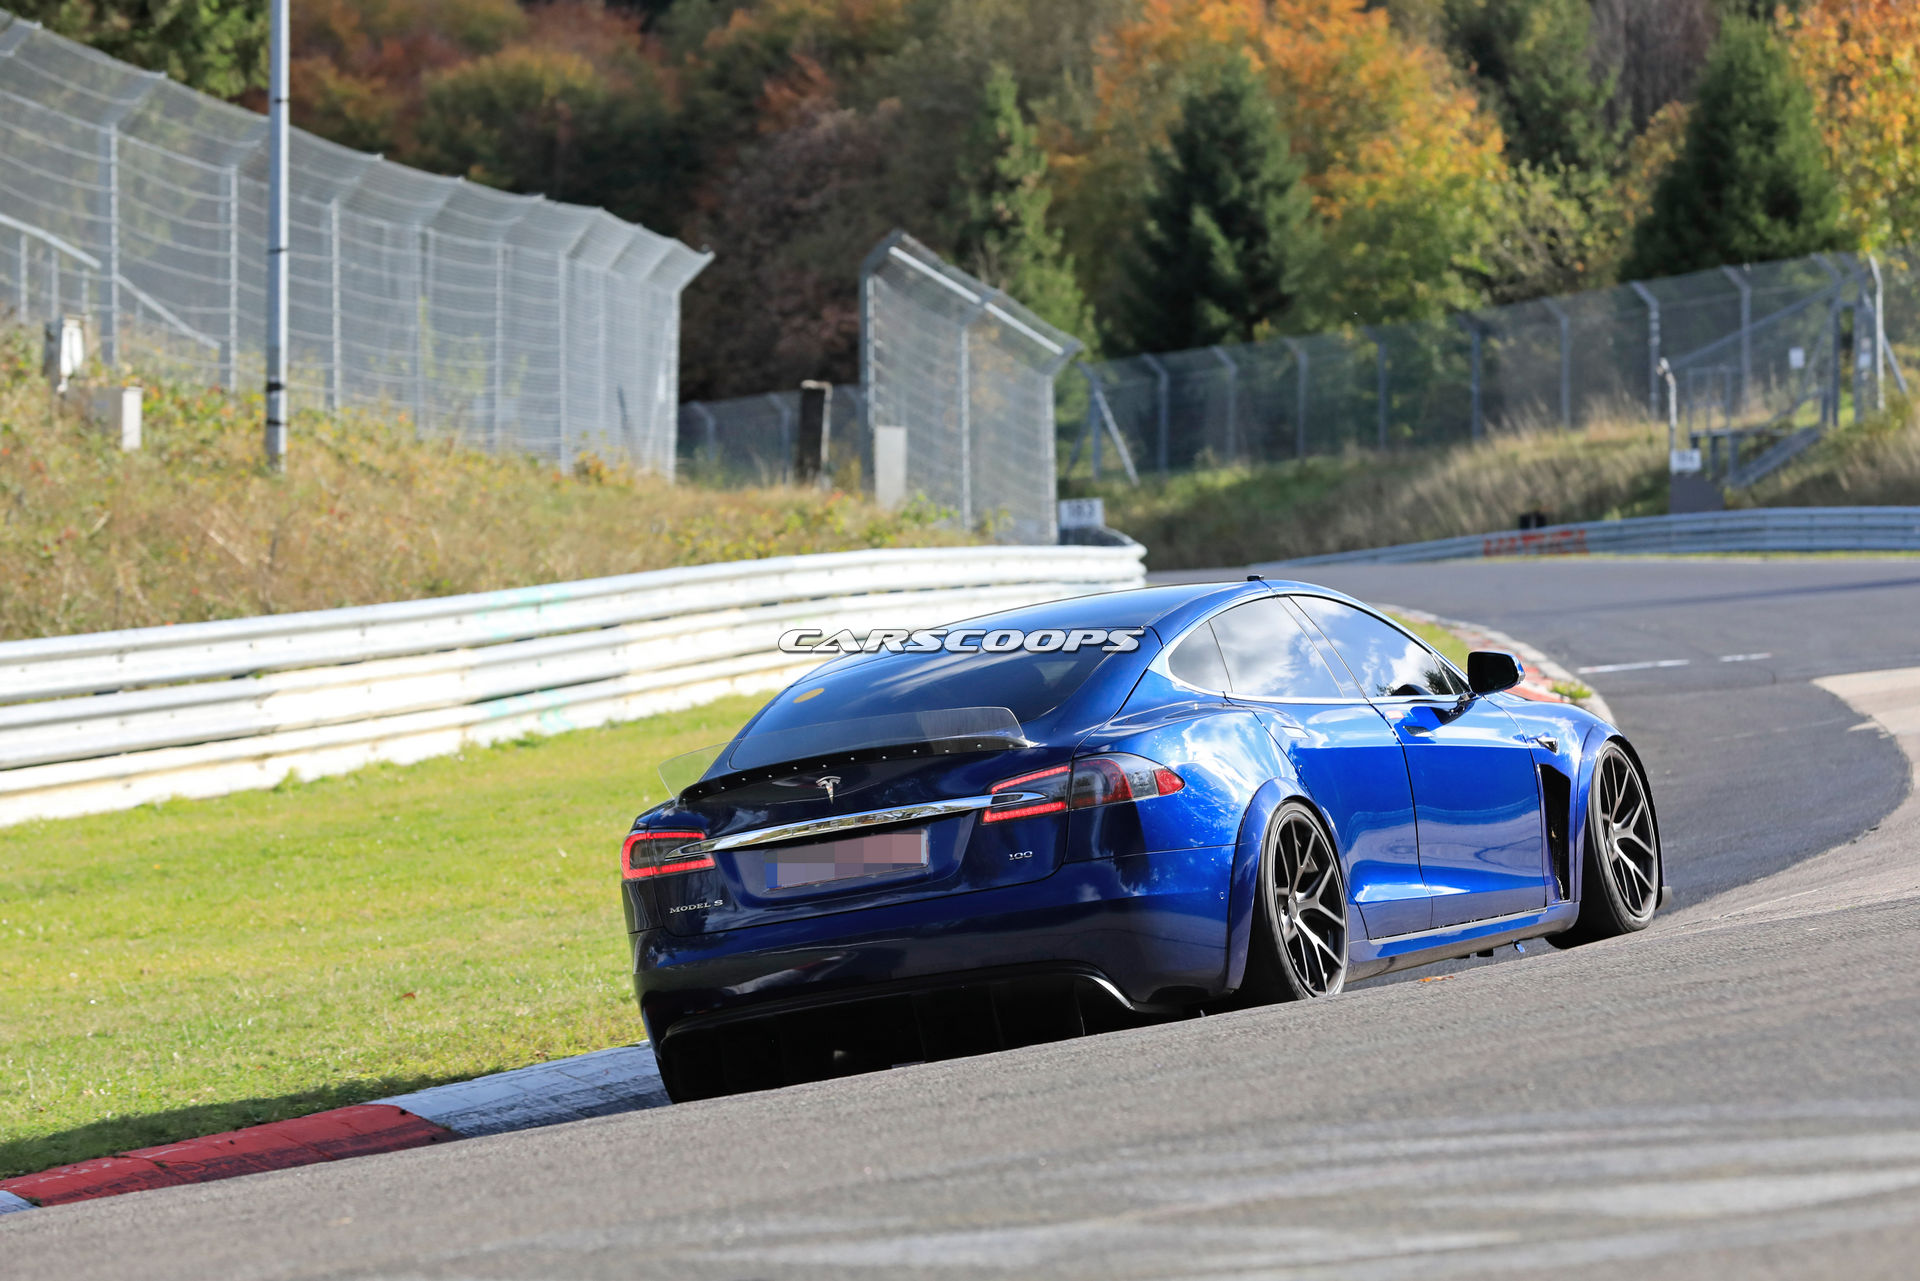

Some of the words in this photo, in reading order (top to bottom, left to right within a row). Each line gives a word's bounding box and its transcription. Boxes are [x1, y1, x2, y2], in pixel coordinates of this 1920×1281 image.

[788, 812, 886, 836] TESLA
[1008, 850, 1033, 861] 100
[669, 902, 712, 914] MODEL
[713, 899, 724, 907] S
